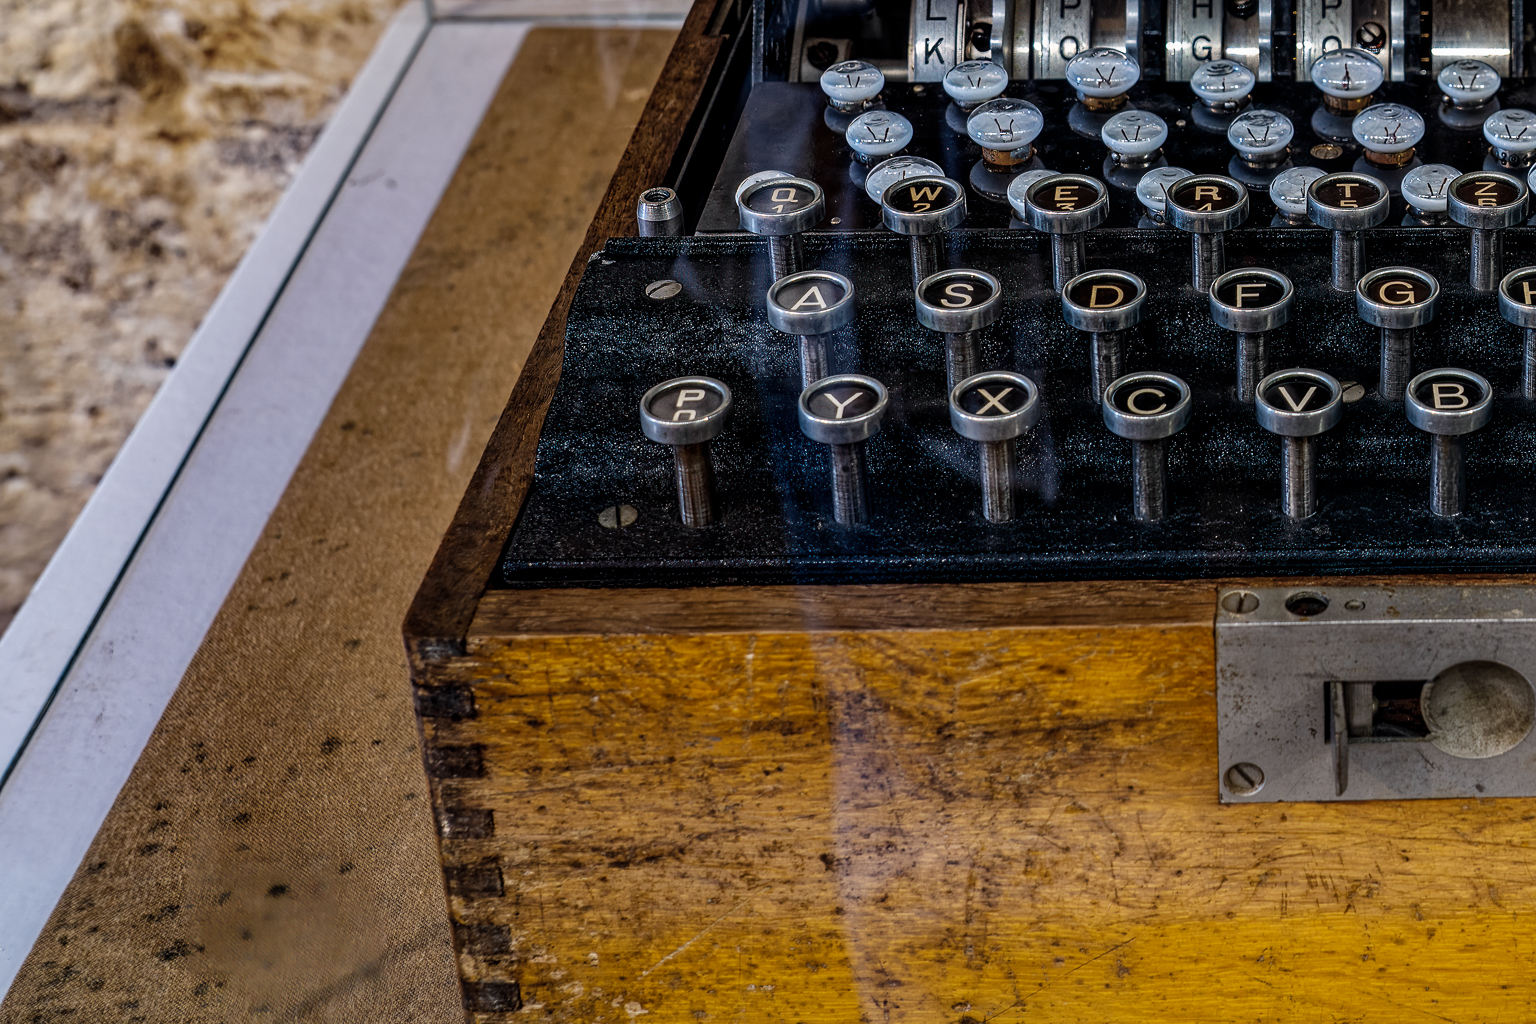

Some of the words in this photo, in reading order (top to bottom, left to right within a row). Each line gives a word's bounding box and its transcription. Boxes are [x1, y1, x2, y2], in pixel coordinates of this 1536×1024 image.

[924, 37, 945, 65] K
[1059, 35, 1079, 61] O
[1192, 35, 1212, 62] G
[771, 187, 799, 203] Q
[909, 186, 943, 202] W
[1054, 185, 1079, 201] E
[1195, 185, 1222, 201] R
[1336, 183, 1360, 198] T
[1474, 181, 1498, 196] Z
[790, 285, 828, 311] A
[940, 283, 974, 308] S
[1089, 285, 1124, 308] D
[1236, 283, 1267, 308] F
[1379, 281, 1415, 305] G
[676, 389, 706, 408] P
[823, 392, 863, 419] Y
[975, 387, 1012, 416] X
[1127, 388, 1167, 415] C
[1278, 386, 1317, 412] V
[1432, 383, 1469, 409] B
